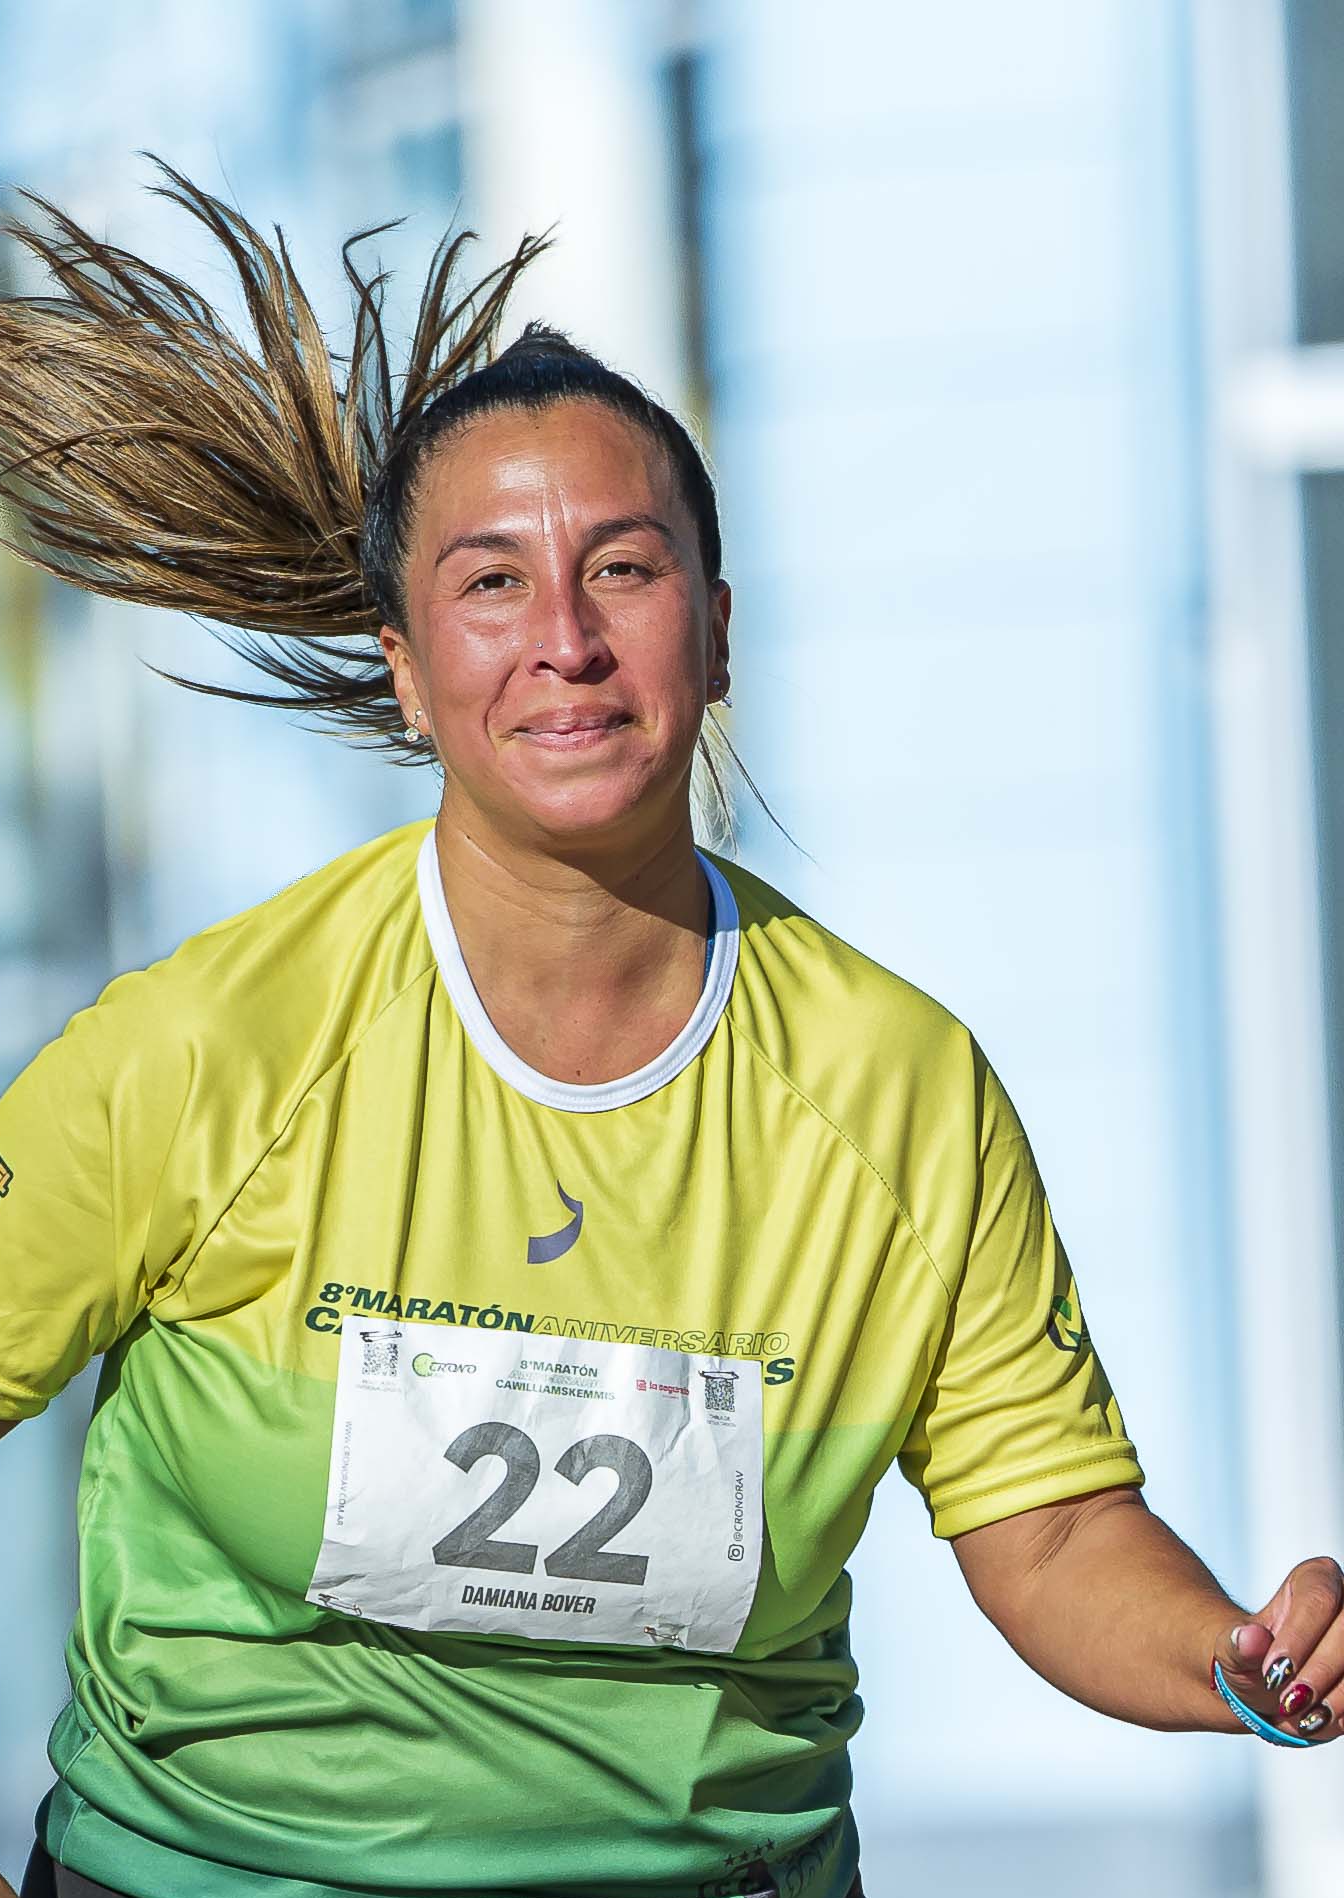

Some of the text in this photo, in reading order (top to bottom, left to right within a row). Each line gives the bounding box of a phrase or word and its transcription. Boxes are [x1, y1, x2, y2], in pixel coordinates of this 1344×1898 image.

[532, 1316, 790, 1356] ANIVERSARIO
[432, 1421, 653, 1586] 22
[733, 1470, 744, 1542] @CRONORAV
[461, 1585, 597, 1615] DAMIANA BOVER
